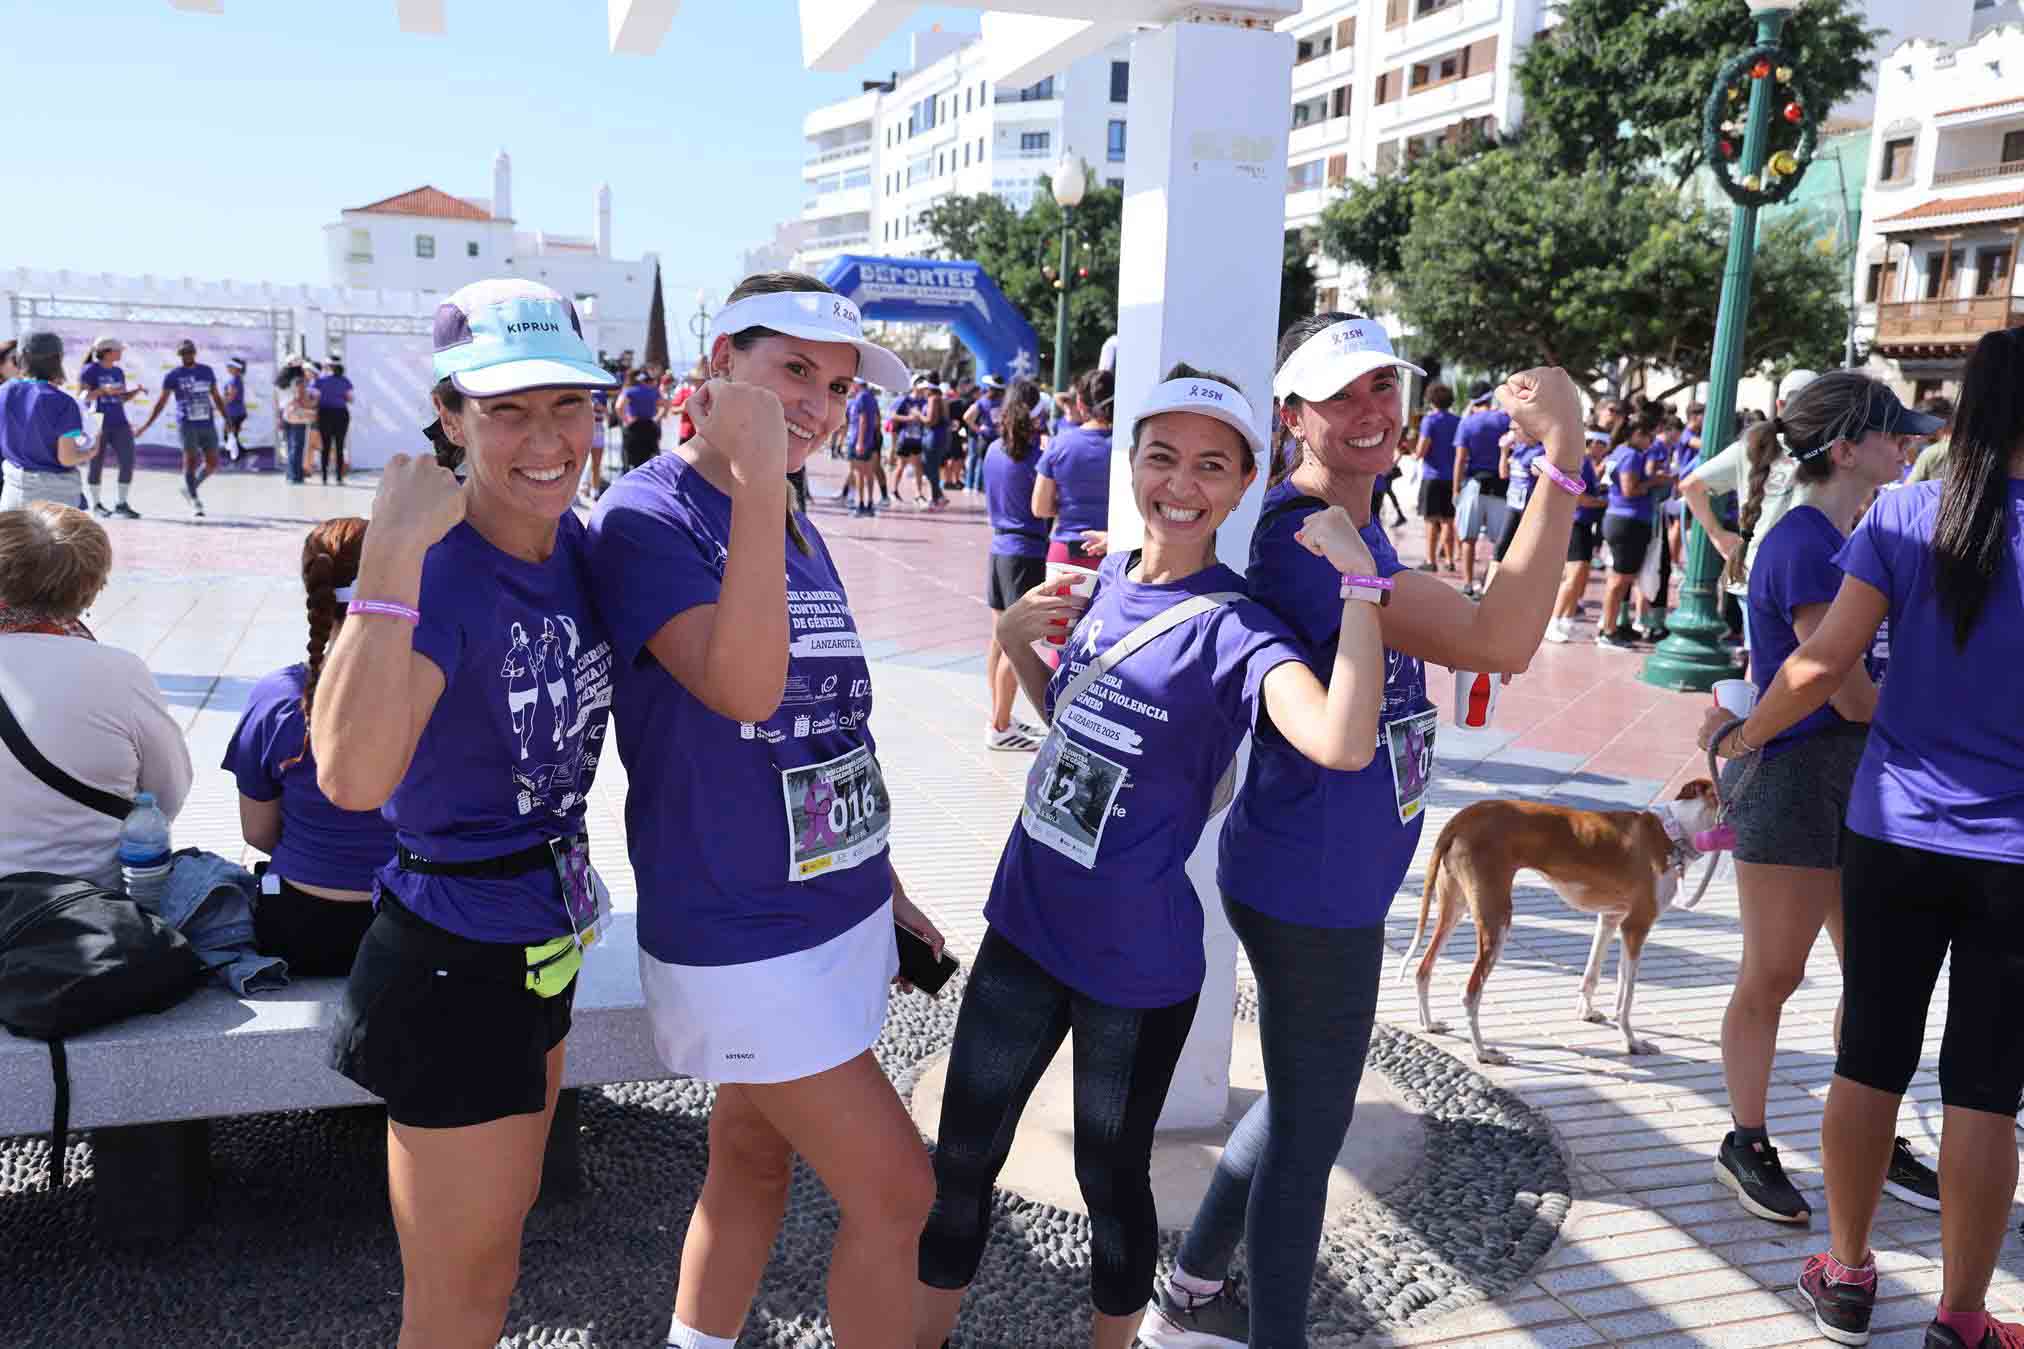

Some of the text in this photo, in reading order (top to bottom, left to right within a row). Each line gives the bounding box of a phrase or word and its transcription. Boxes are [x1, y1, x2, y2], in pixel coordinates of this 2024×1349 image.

[859, 264, 976, 288] DEPORTES
[507, 322, 559, 333] KIPRUN
[1342, 328, 1364, 340] 25N
[1200, 388, 1223, 401] 25N
[801, 591, 843, 602] CARRERA
[788, 603, 828, 615] CONTRA
[828, 603, 841, 614] LA
[792, 614, 845, 629] DE GÉNERO
[811, 639, 855, 650] LANZAROTE
[1109, 690, 1169, 722] VIOLENCIA
[1101, 727, 1121, 741] 2025
[828, 782, 876, 833] 016
